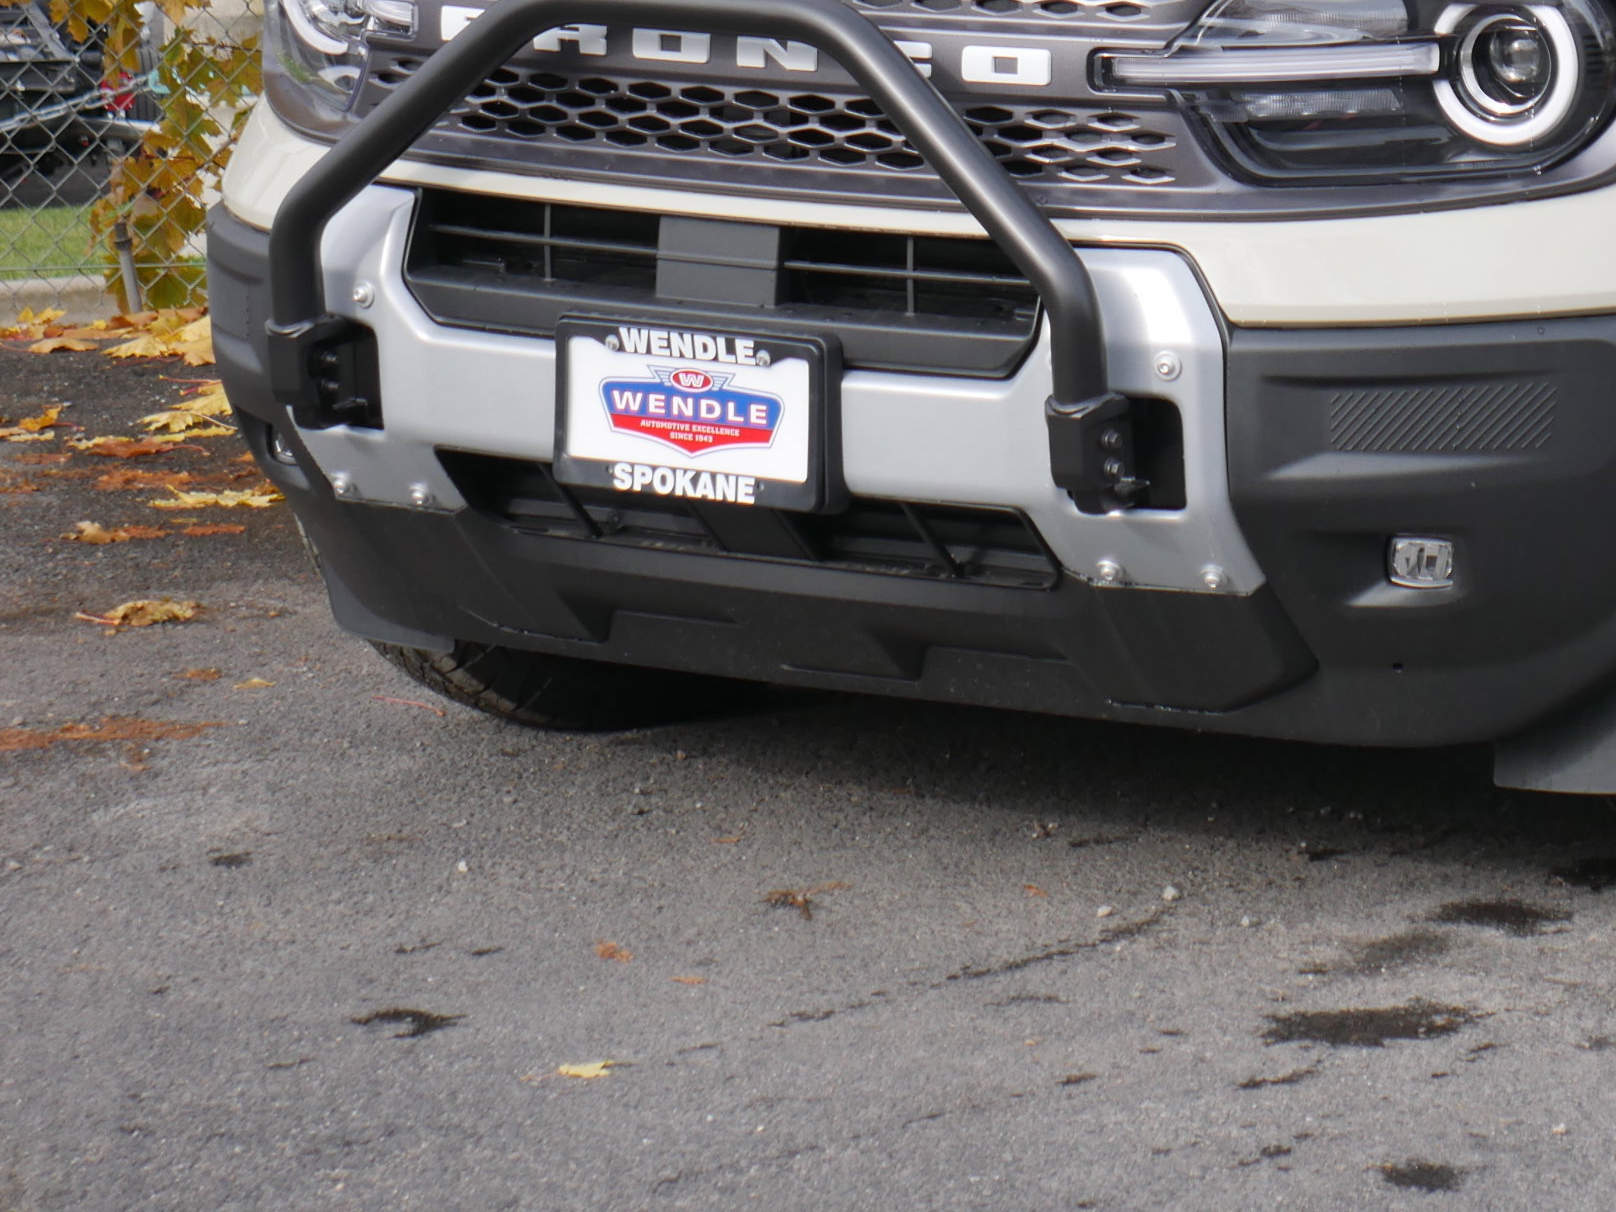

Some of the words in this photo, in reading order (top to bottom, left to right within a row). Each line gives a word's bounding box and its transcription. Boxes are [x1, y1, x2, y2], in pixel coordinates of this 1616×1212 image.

[618, 326, 757, 365] WENDLE
[611, 390, 768, 425] WENDLE
[640, 419, 691, 432] AUTOMOTIVE
[691, 424, 741, 437] EXCELLENCE
[669, 431, 694, 441] SINCE
[695, 434, 714, 443] 1943
[612, 462, 756, 505] SPOKANE
